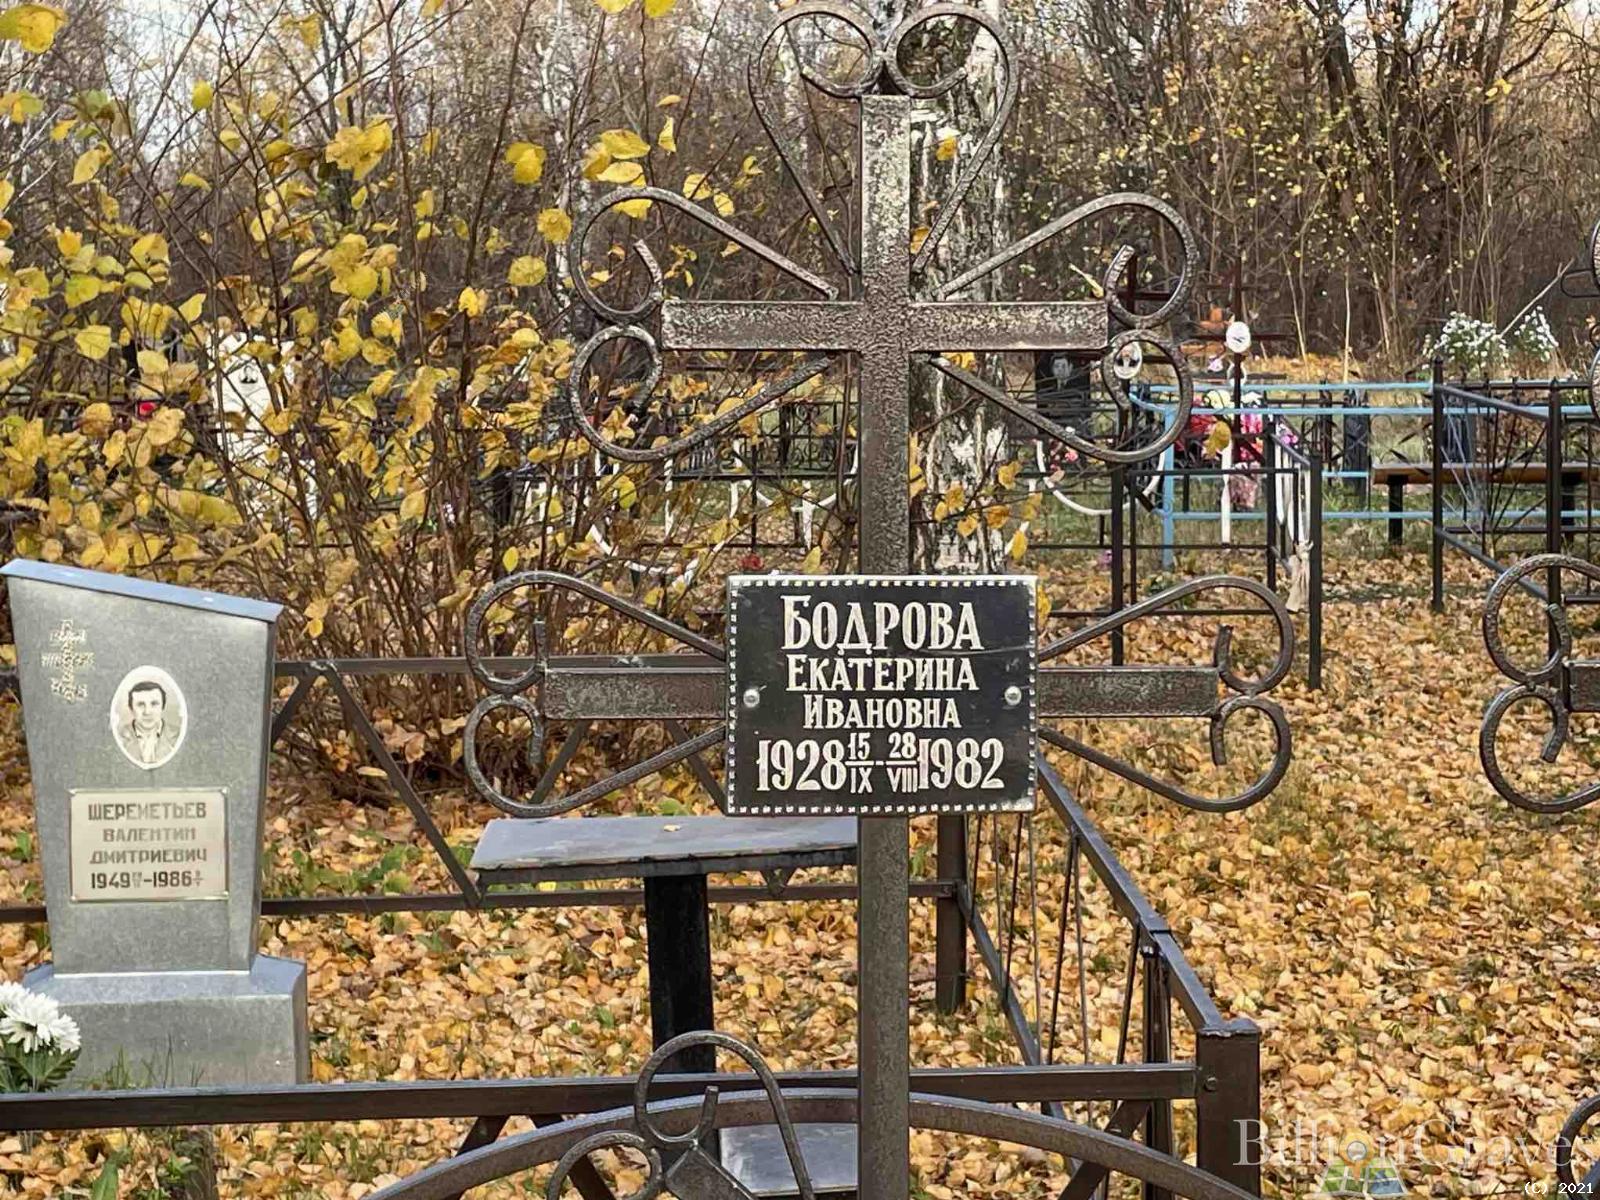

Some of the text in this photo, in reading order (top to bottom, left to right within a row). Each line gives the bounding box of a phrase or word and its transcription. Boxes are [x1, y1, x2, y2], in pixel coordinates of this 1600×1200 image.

[780, 595, 985, 655] БОДРОВА
[785, 653, 980, 692] ЕКАТЕРИНА
[803, 694, 962, 730] ИВАНОВНА
[756, 739, 847, 792] 1928
[917, 737, 1005, 790] 1982
[88, 802, 207, 821] ШЕРЕМЕТЬЕВ
[102, 827, 197, 842] ВАЛЕНТИН
[89, 848, 207, 865] ДМИТРИЕВИЧ
